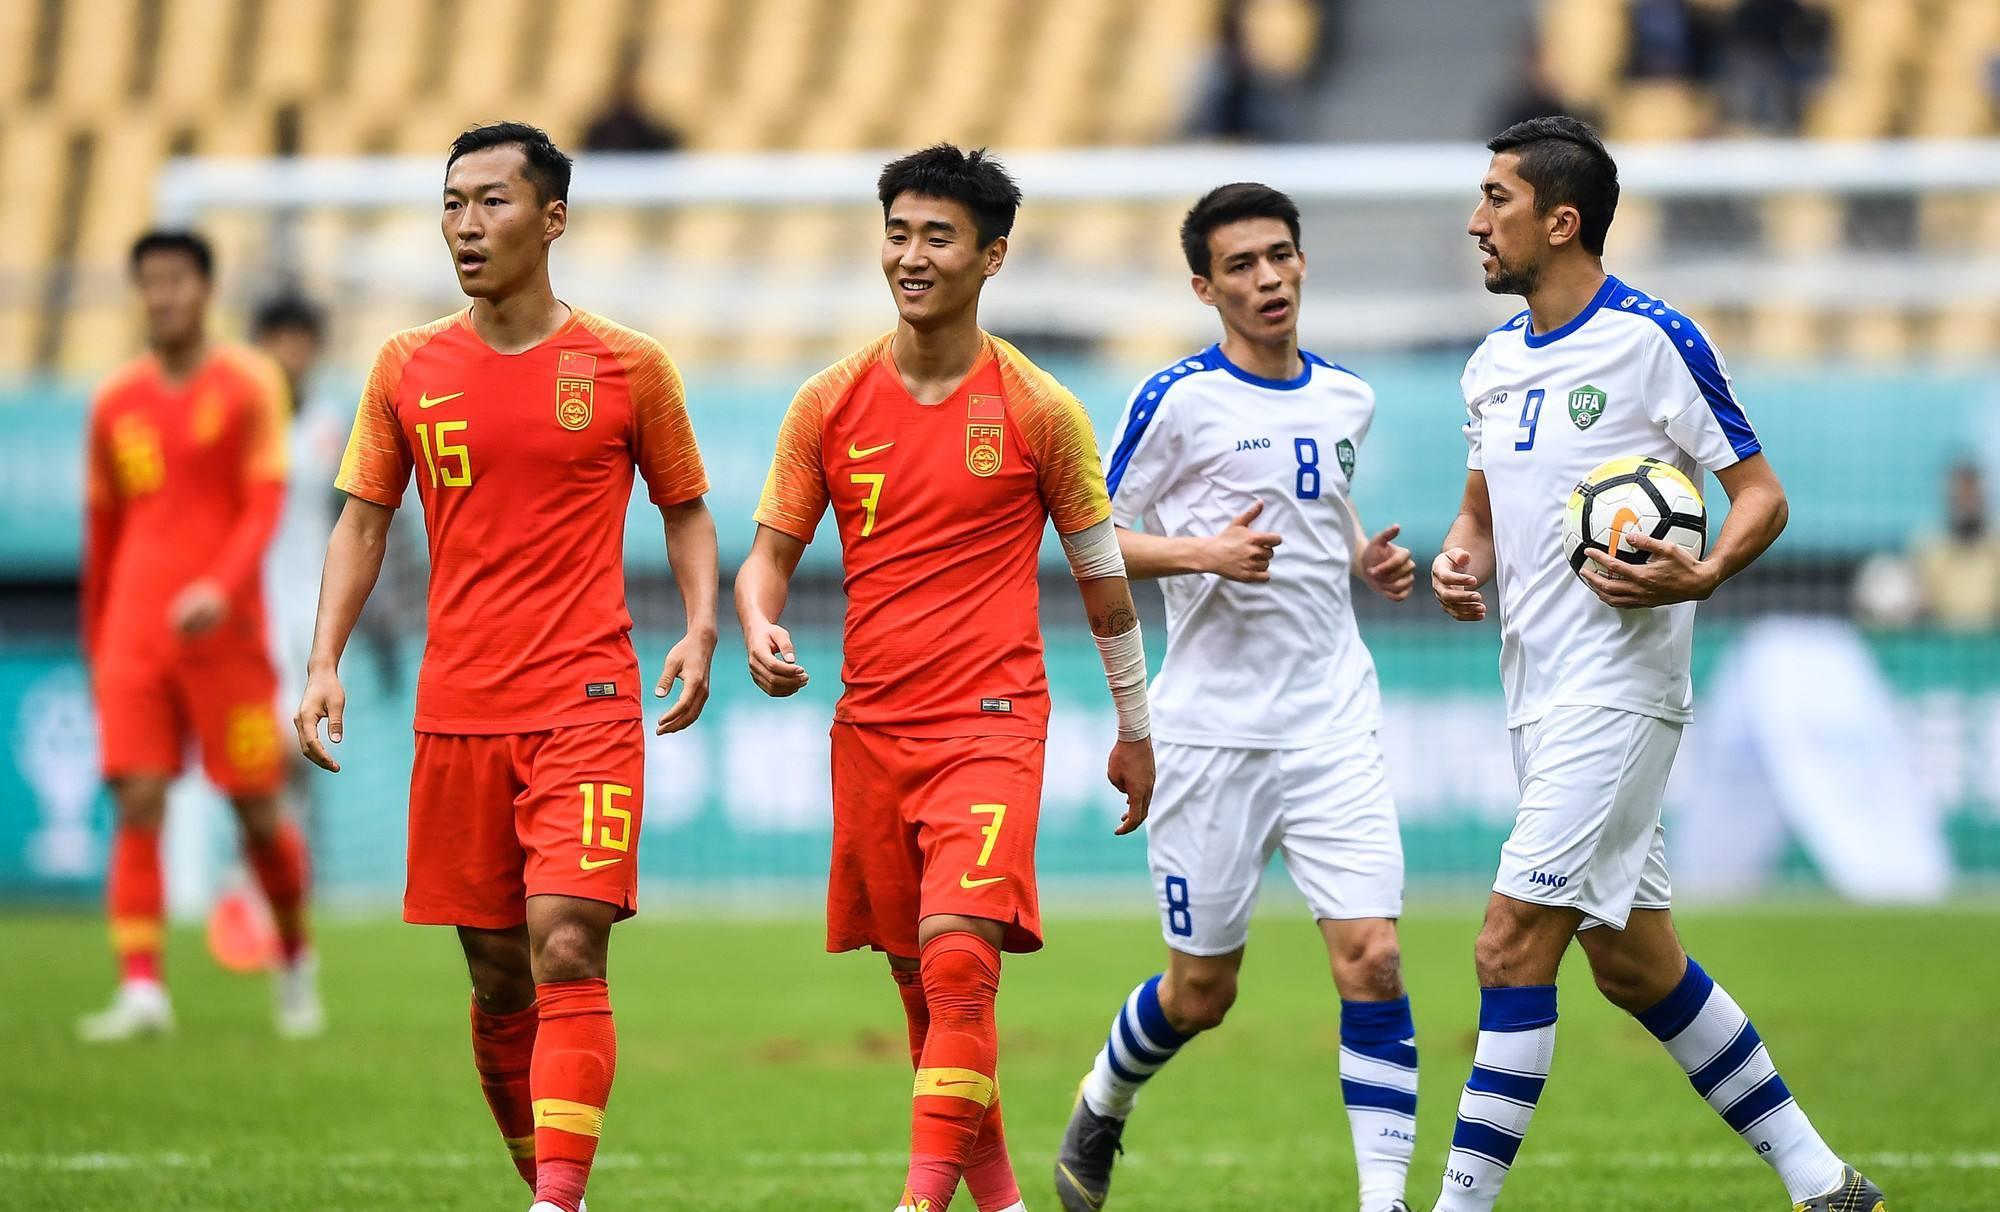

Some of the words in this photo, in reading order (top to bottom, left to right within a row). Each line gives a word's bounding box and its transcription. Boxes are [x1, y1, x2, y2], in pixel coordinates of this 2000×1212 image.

[560, 382, 590, 392] CFA
[1571, 393, 1600, 411] UFA
[970, 427, 1000, 438] CFA
[1235, 437, 1271, 452] JAKO
[1514, 388, 1546, 452] 9
[415, 420, 472, 489] 15
[1293, 437, 1322, 501] 8
[849, 473, 886, 538] 7
[578, 783, 633, 853] 15
[970, 803, 1007, 867] 7
[1164, 874, 1194, 939] 8
[1528, 870, 1569, 888] JAKO
